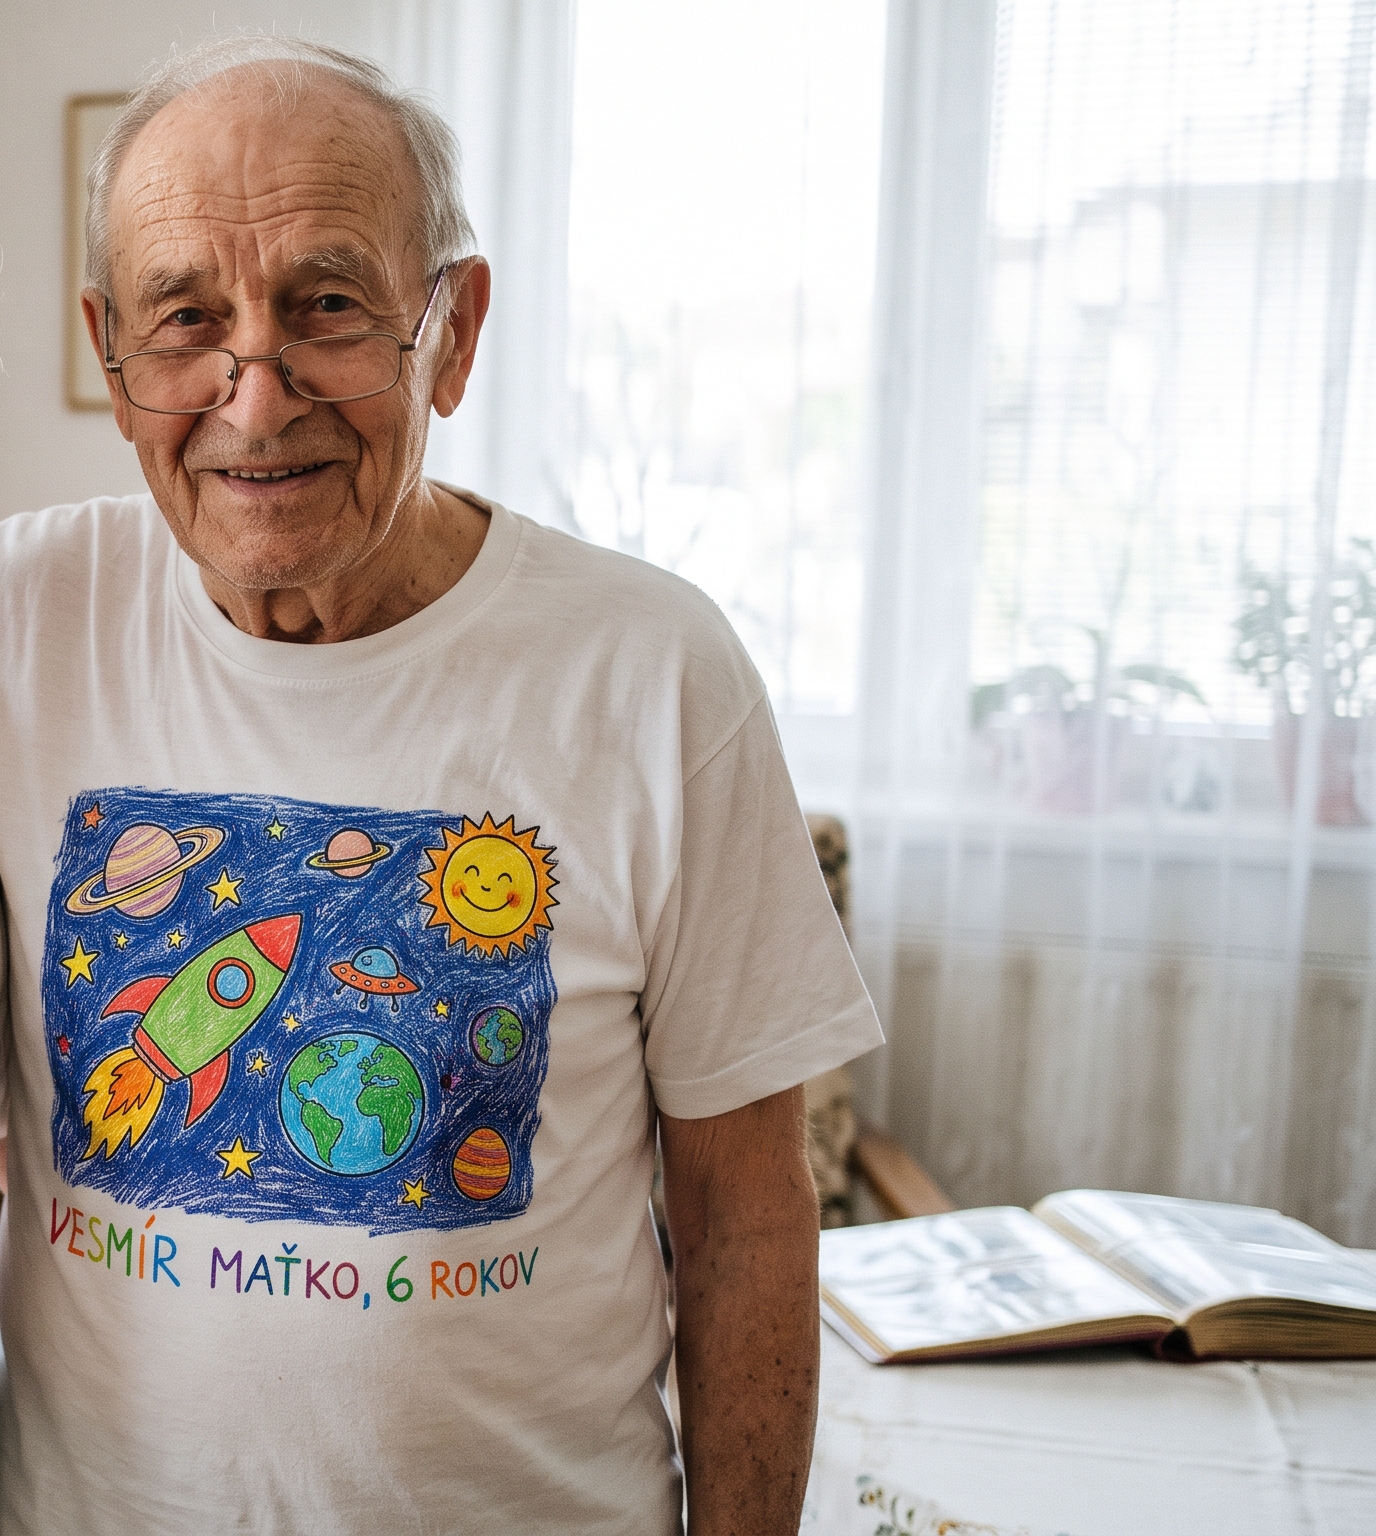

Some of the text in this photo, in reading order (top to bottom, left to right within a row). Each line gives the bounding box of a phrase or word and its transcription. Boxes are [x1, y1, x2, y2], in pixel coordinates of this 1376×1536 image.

[51, 1197, 539, 1310] VESMÍR MAŤKO, 6 ROKOV
